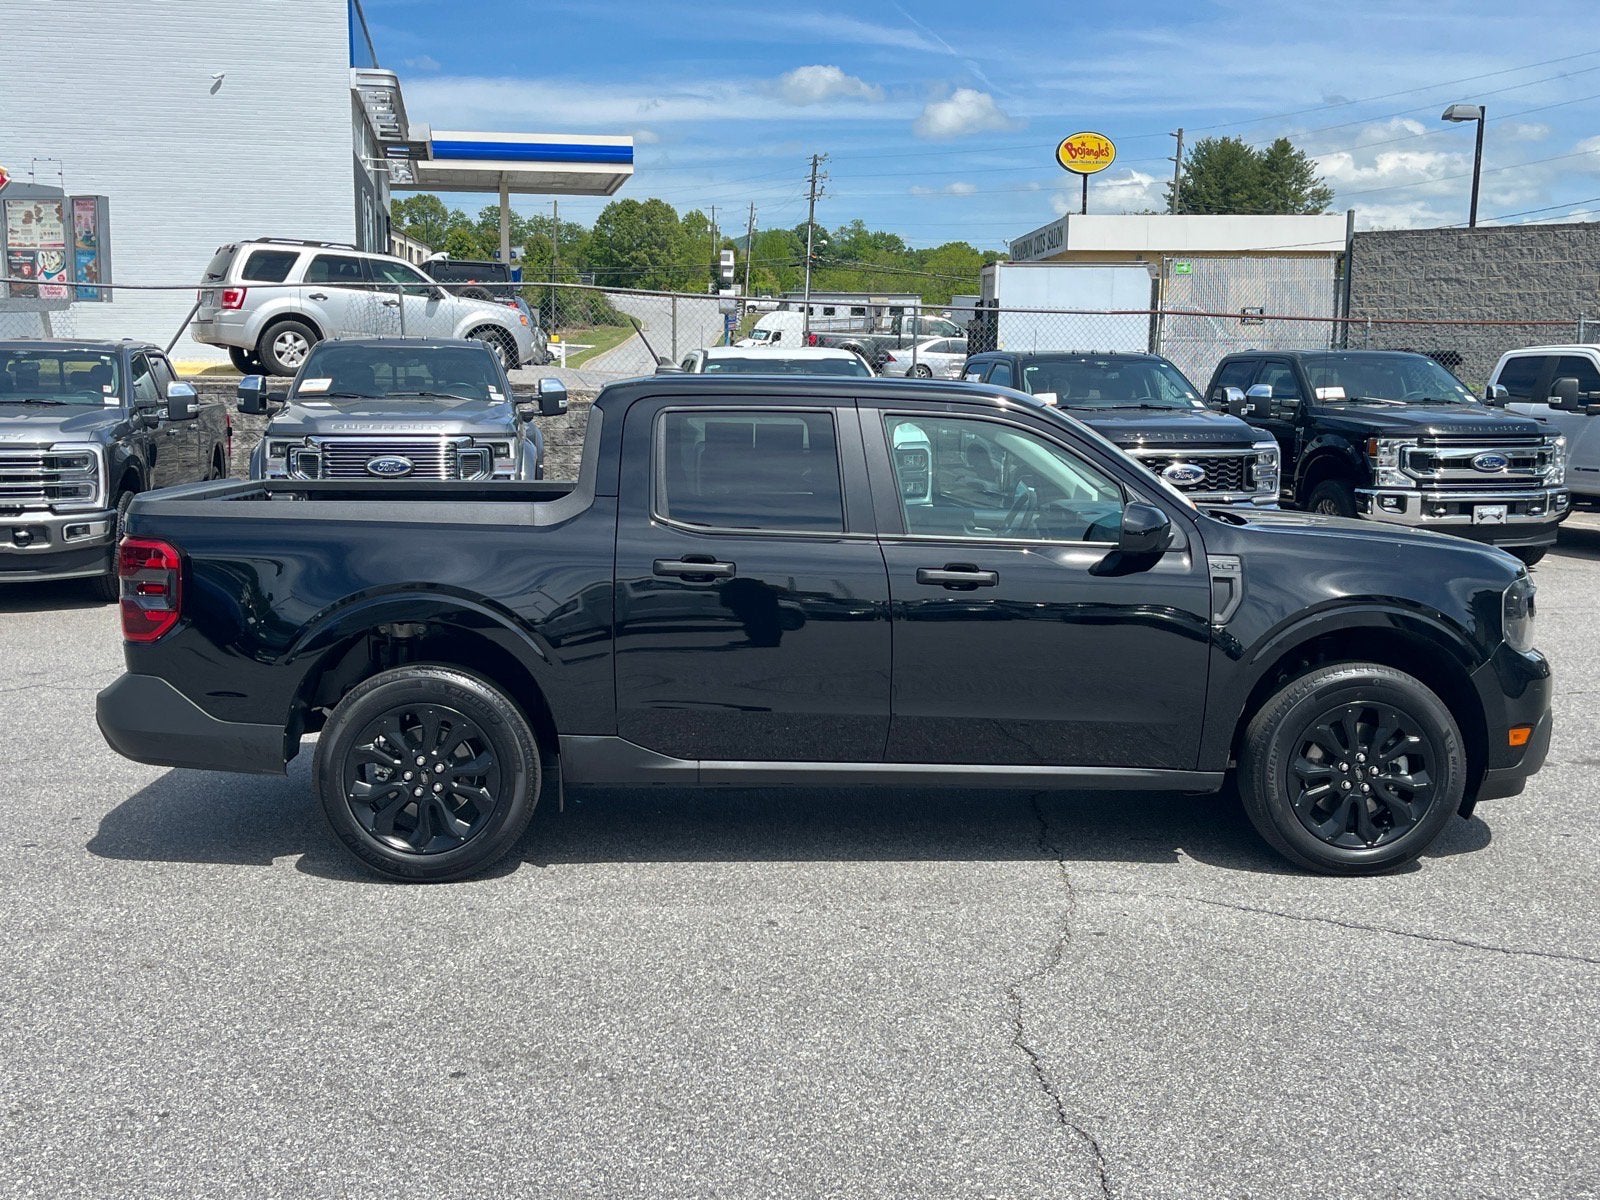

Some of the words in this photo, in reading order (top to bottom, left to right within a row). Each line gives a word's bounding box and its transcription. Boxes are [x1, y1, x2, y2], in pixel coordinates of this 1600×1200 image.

[1047, 226, 1063, 251] SALON
[377, 461, 401, 471] Ford
[1482, 458, 1501, 467] Ford
[1174, 469, 1194, 479] Ford
